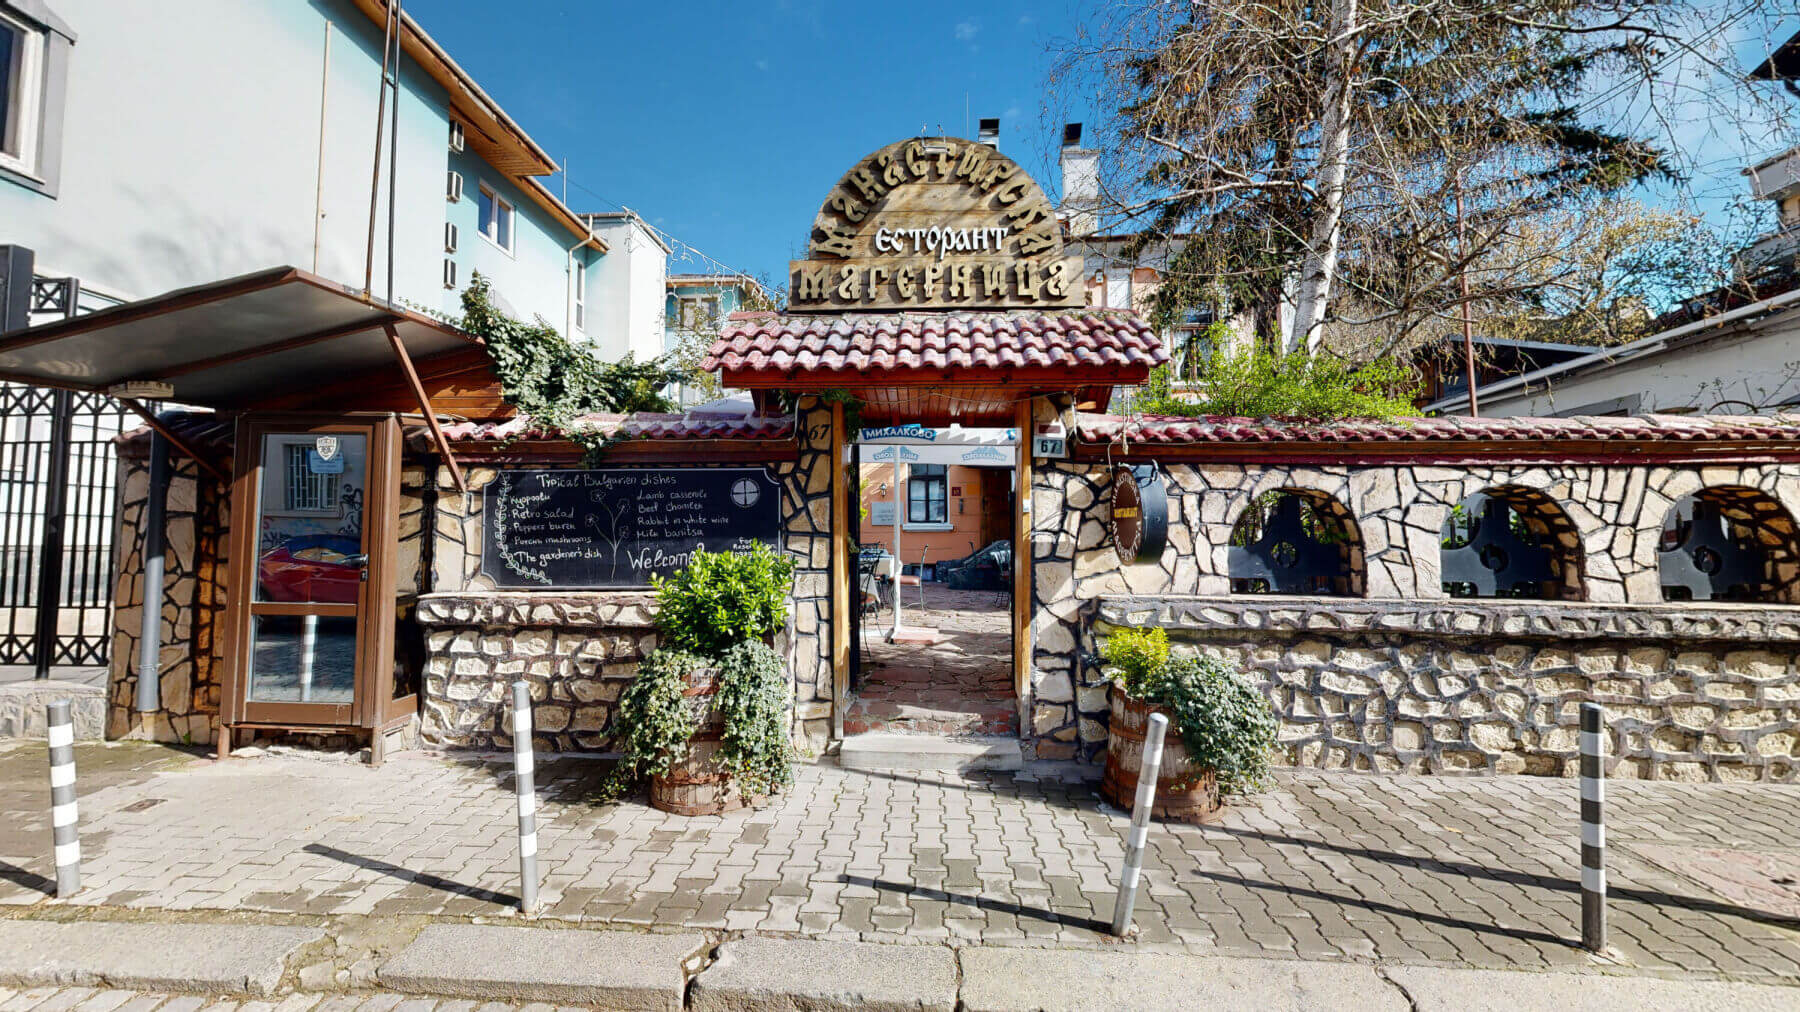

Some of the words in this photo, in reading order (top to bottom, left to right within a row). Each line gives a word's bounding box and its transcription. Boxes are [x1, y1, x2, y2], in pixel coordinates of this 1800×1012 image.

[809, 423, 831, 440] 67
[866, 428, 934, 439] МИХАЛКОВО
[1040, 439, 1058, 453] 67
[536, 474, 580, 488] Typical
[641, 473, 677, 486] dishes
[637, 489, 665, 500] Lamb
[512, 508, 541, 519] Retro
[543, 506, 575, 519] salad
[682, 513, 708, 525] white
[710, 516, 729, 525] wine
[664, 524, 705, 538] banitsa
[513, 550, 538, 563] The
[584, 547, 603, 559] dish
